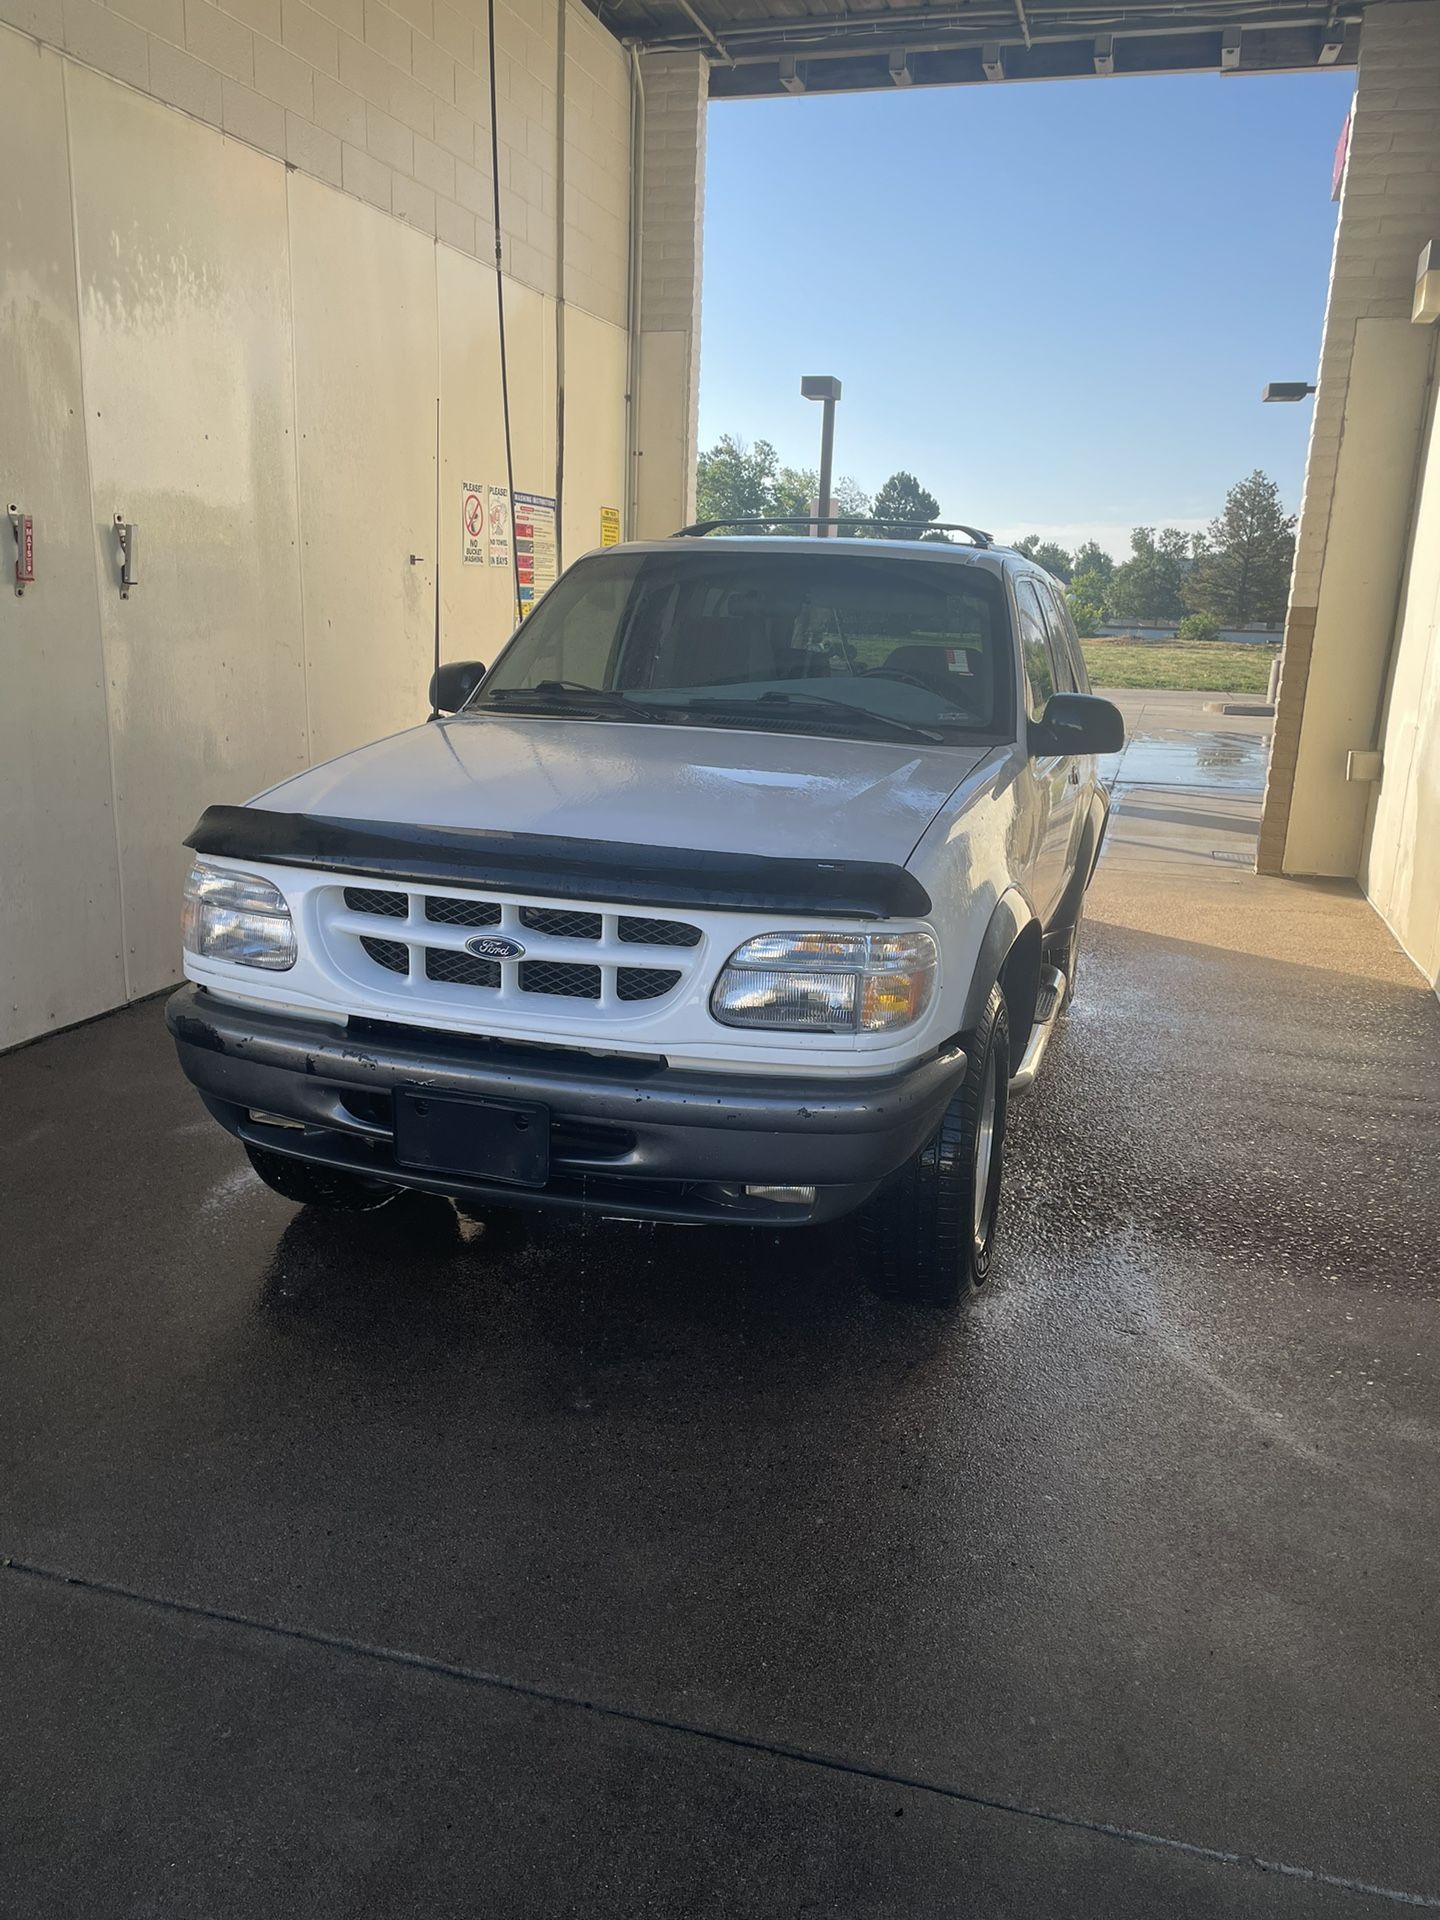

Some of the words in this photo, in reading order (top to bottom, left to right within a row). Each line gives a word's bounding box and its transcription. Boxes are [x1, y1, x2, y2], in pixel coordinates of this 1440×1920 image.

[469, 539, 478, 548] NO
[466, 547, 482, 555] BUCKET
[464, 555, 484, 564] WASHING
[489, 556, 495, 564] IN
[496, 556, 508, 565] BAYS
[479, 940, 510, 955] Ford
